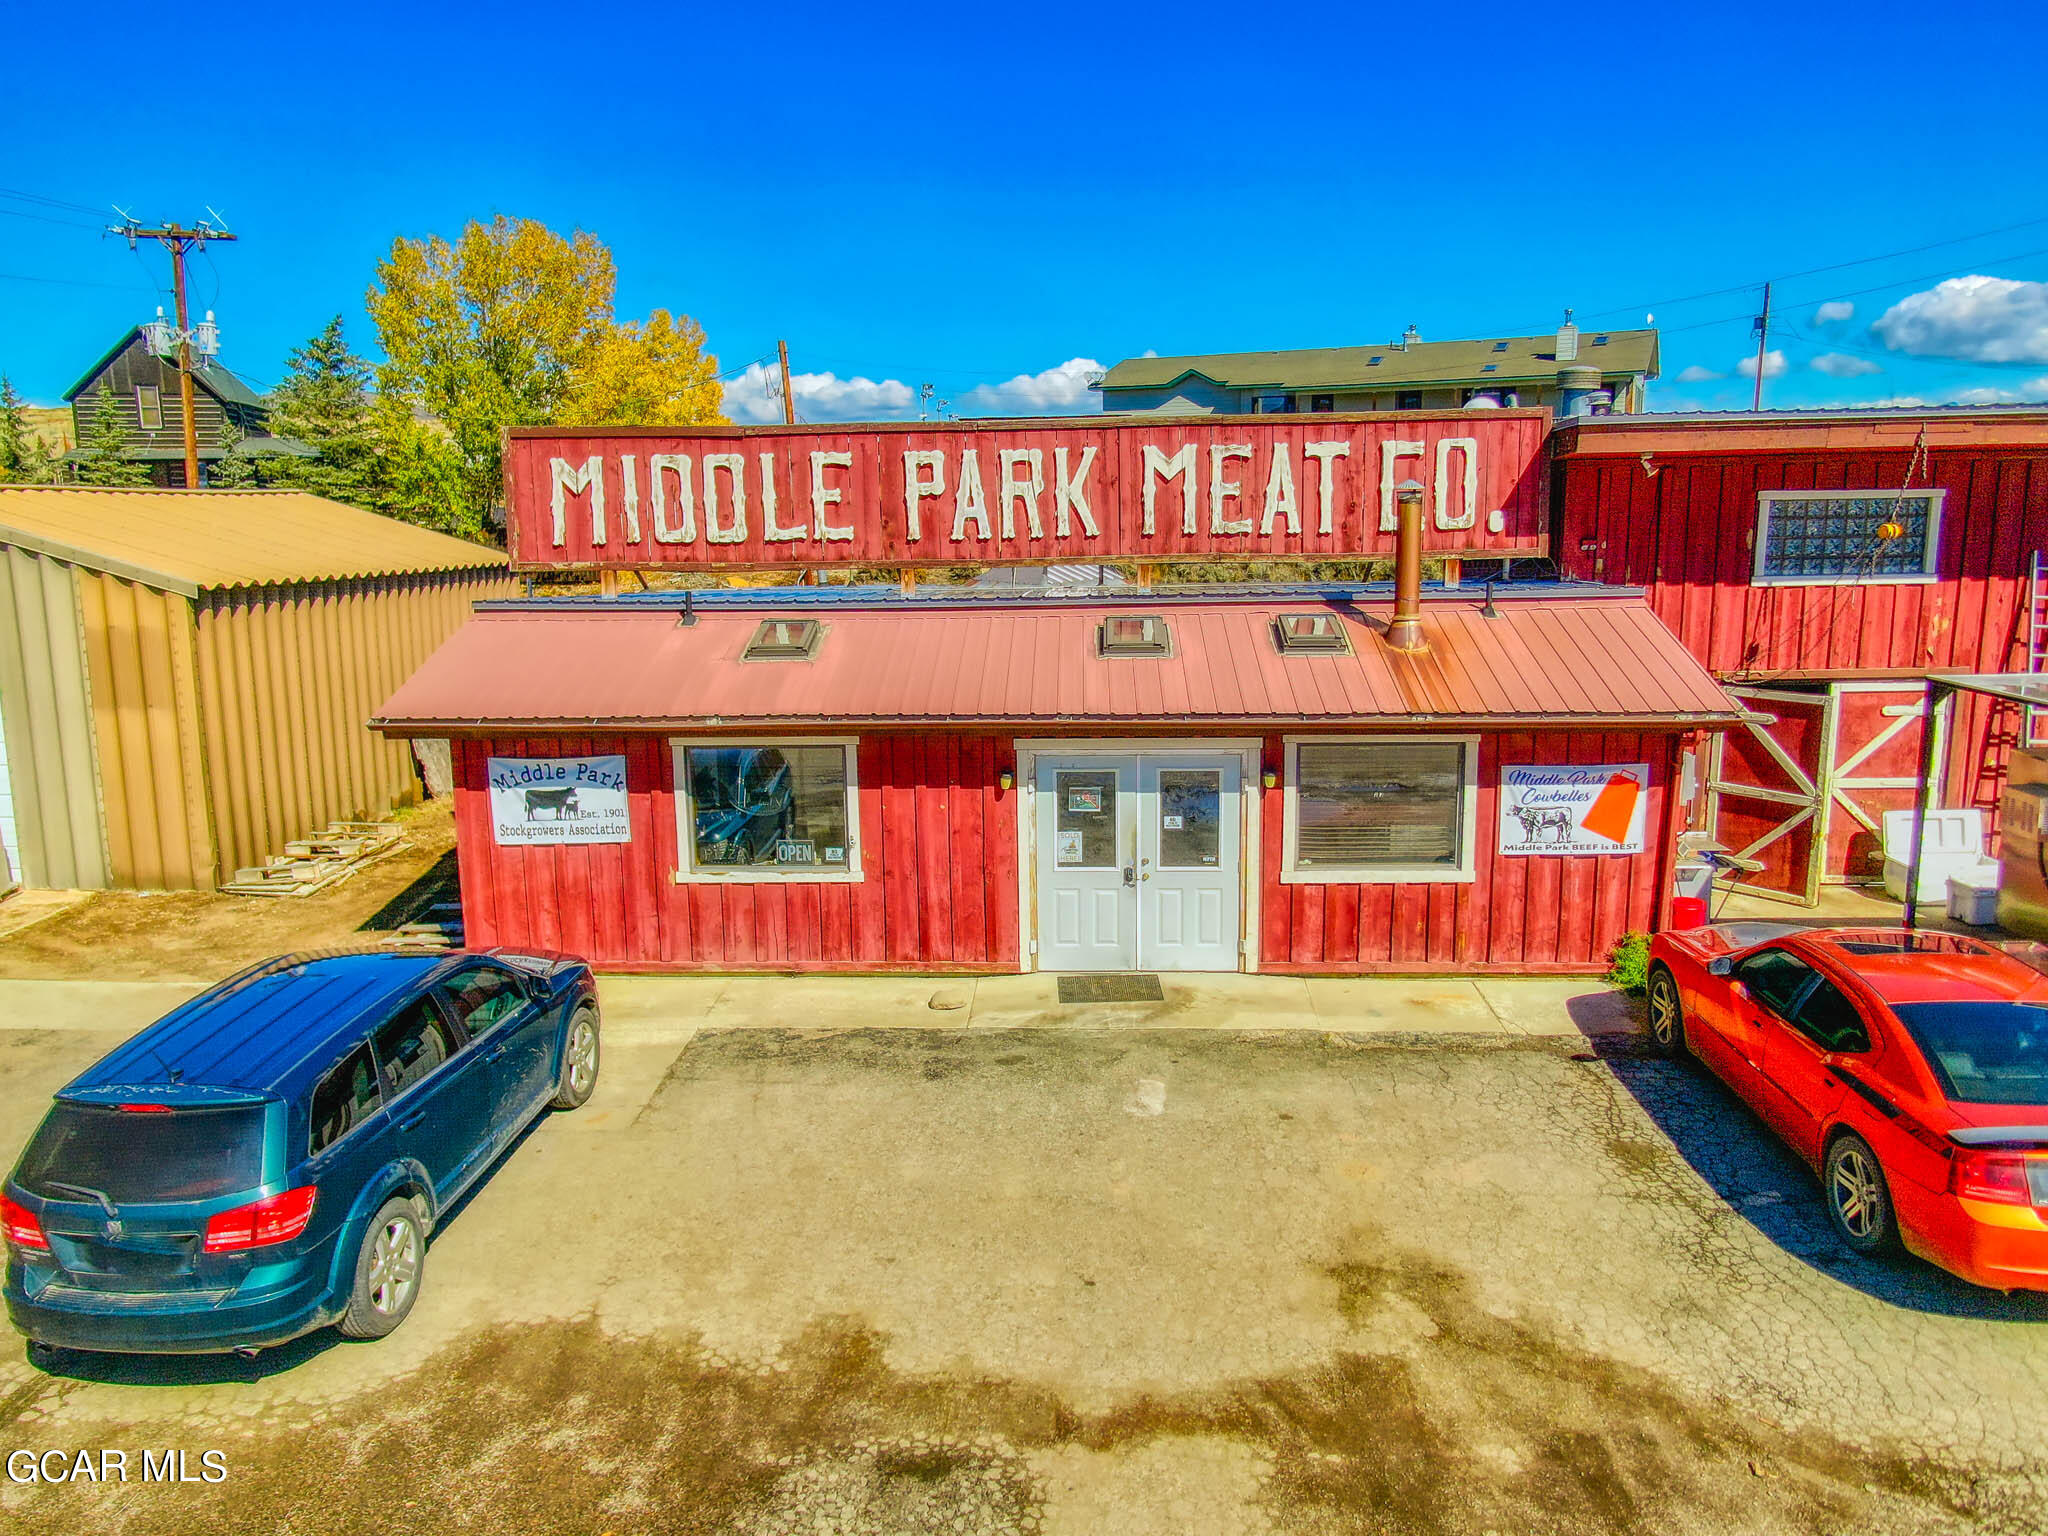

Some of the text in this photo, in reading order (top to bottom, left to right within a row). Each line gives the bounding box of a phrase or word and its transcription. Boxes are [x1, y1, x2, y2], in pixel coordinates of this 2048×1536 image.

[550, 450, 855, 547] MIDDLE
[902, 445, 1101, 542] PARK
[1141, 439, 1352, 536] MEAT
[492, 763, 625, 793] Middle Park
[1508, 769, 1608, 787] Middle Park
[1521, 786, 1592, 805] Cowbelles
[580, 808, 625, 819] Est. 1901
[500, 822, 627, 839] Stockgrowers Association
[778, 844, 812, 862] OPEN
[1545, 843, 1569, 851] Park
[1601, 842, 1609, 850] is
[1611, 842, 1638, 850] BEST
